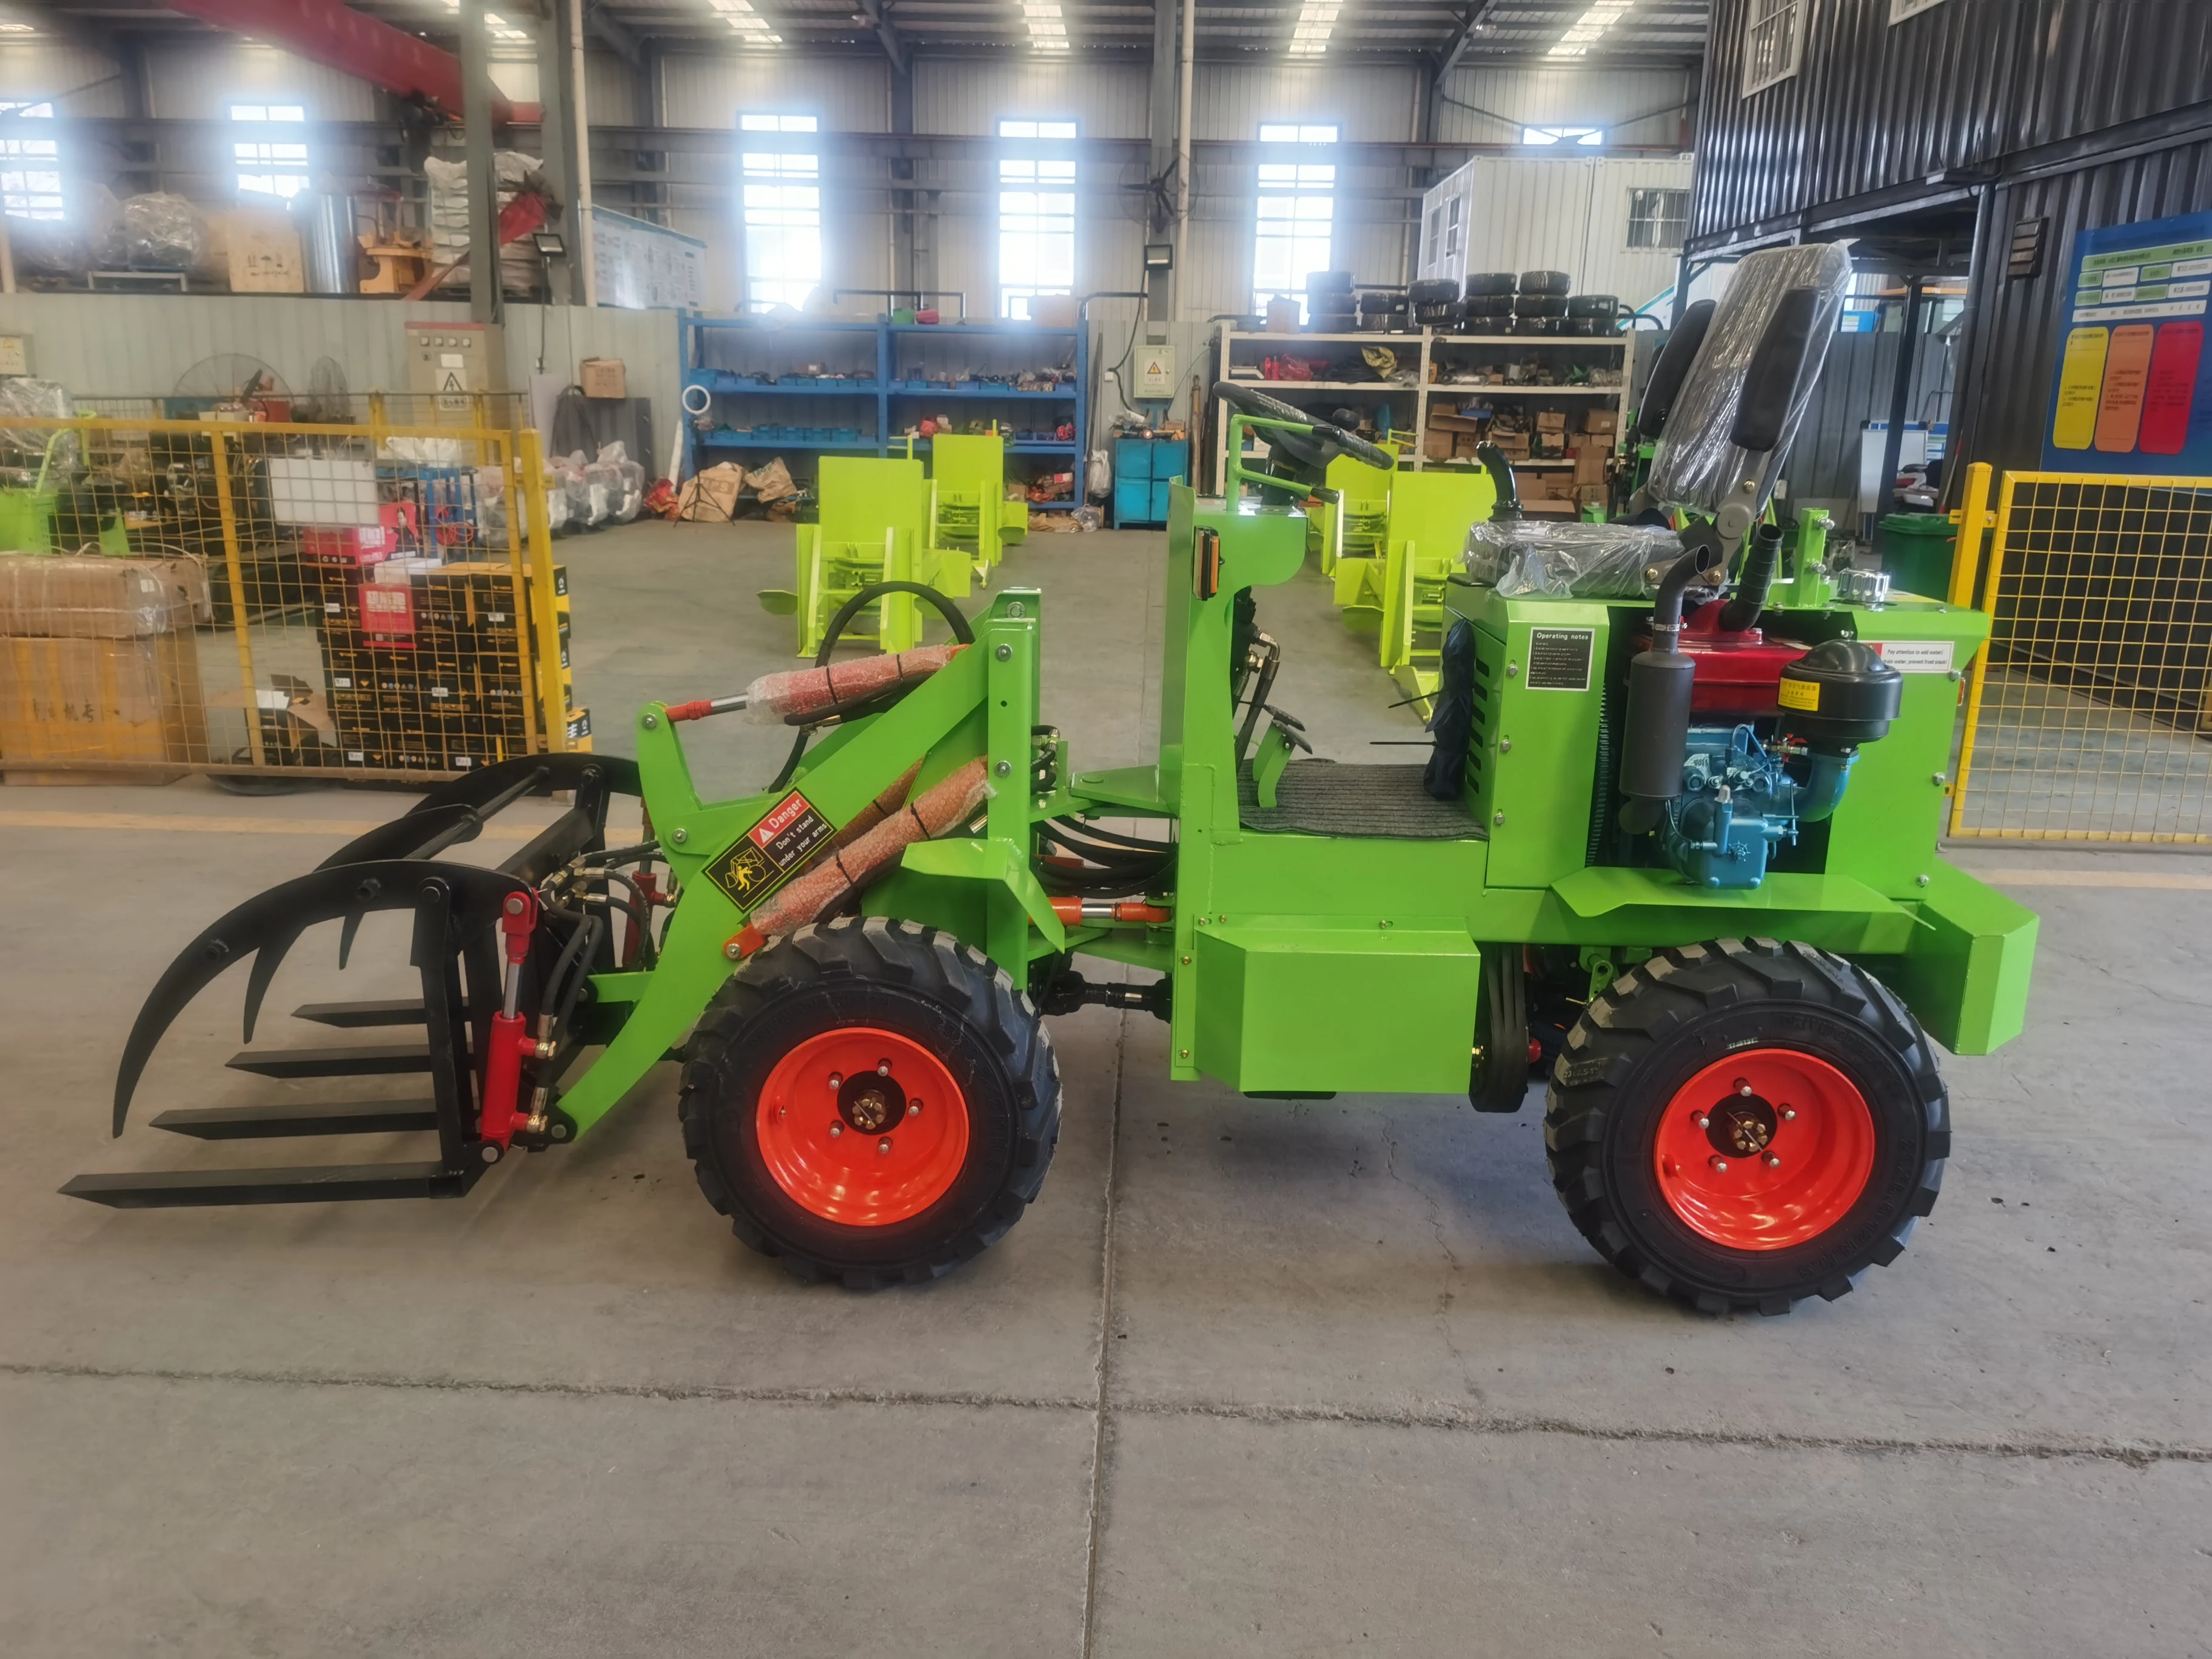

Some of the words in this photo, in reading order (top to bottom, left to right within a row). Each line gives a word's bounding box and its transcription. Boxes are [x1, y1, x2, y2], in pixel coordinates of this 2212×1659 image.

[768, 799, 802, 829] Danger
[776, 831, 796, 850] Don't
[796, 815, 814, 833] stand
[779, 850, 796, 866] under
[796, 836, 811, 852] your
[812, 823, 828, 838] arms
